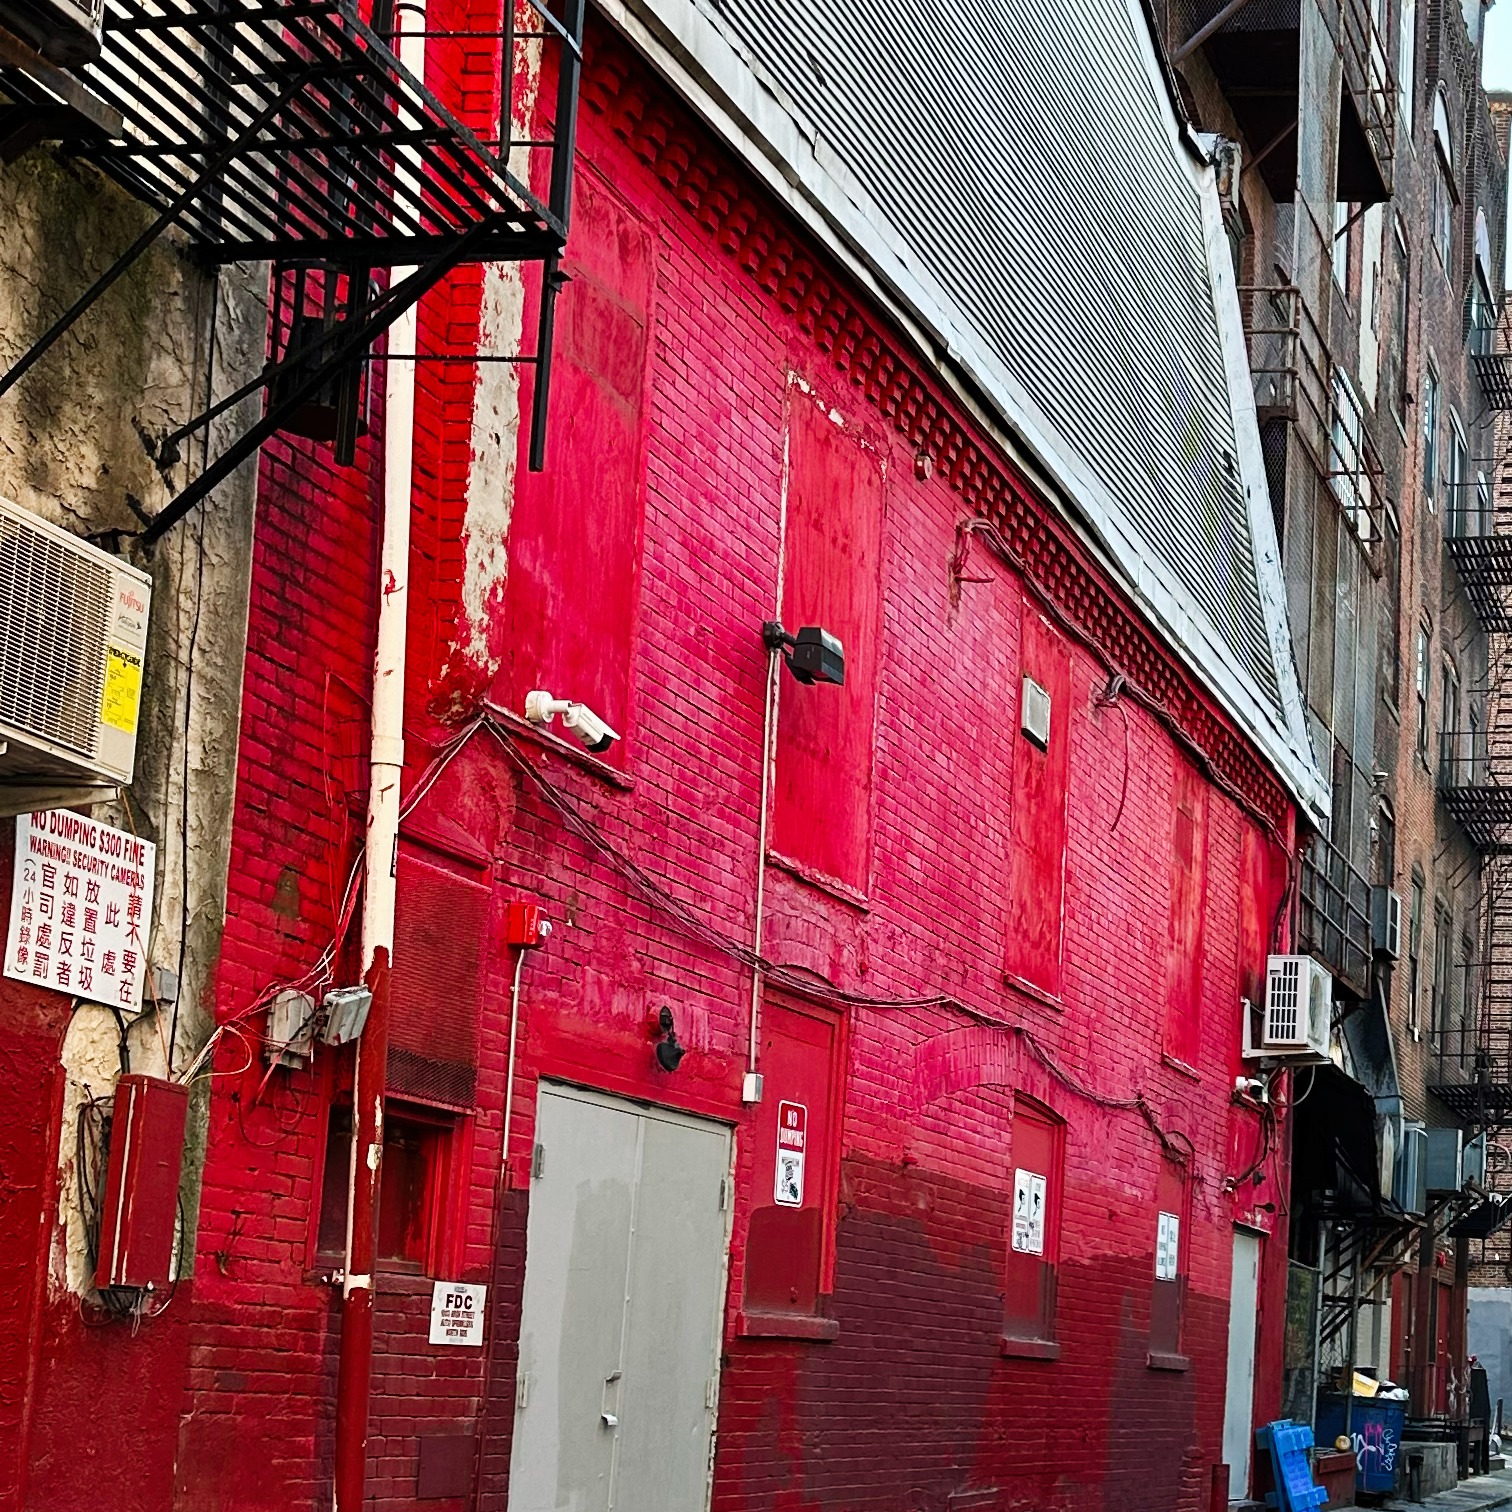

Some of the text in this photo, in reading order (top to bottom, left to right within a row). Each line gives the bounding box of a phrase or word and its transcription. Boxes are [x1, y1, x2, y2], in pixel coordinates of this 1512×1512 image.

[119, 591, 145, 613] FUJITSU
[29, 835, 145, 891] WARNING!! SECURITY CAMERAS
[30, 810, 146, 867] NO DUMPING $300 FINE
[32, 862, 58, 980] 官司處罰
[57, 870, 79, 987] 如違反者
[78, 877, 101, 993] 放置垃圾
[101, 900, 120, 977] 此處
[118, 892, 143, 1005] 請不要在
[445, 1293, 473, 1310] FDC
